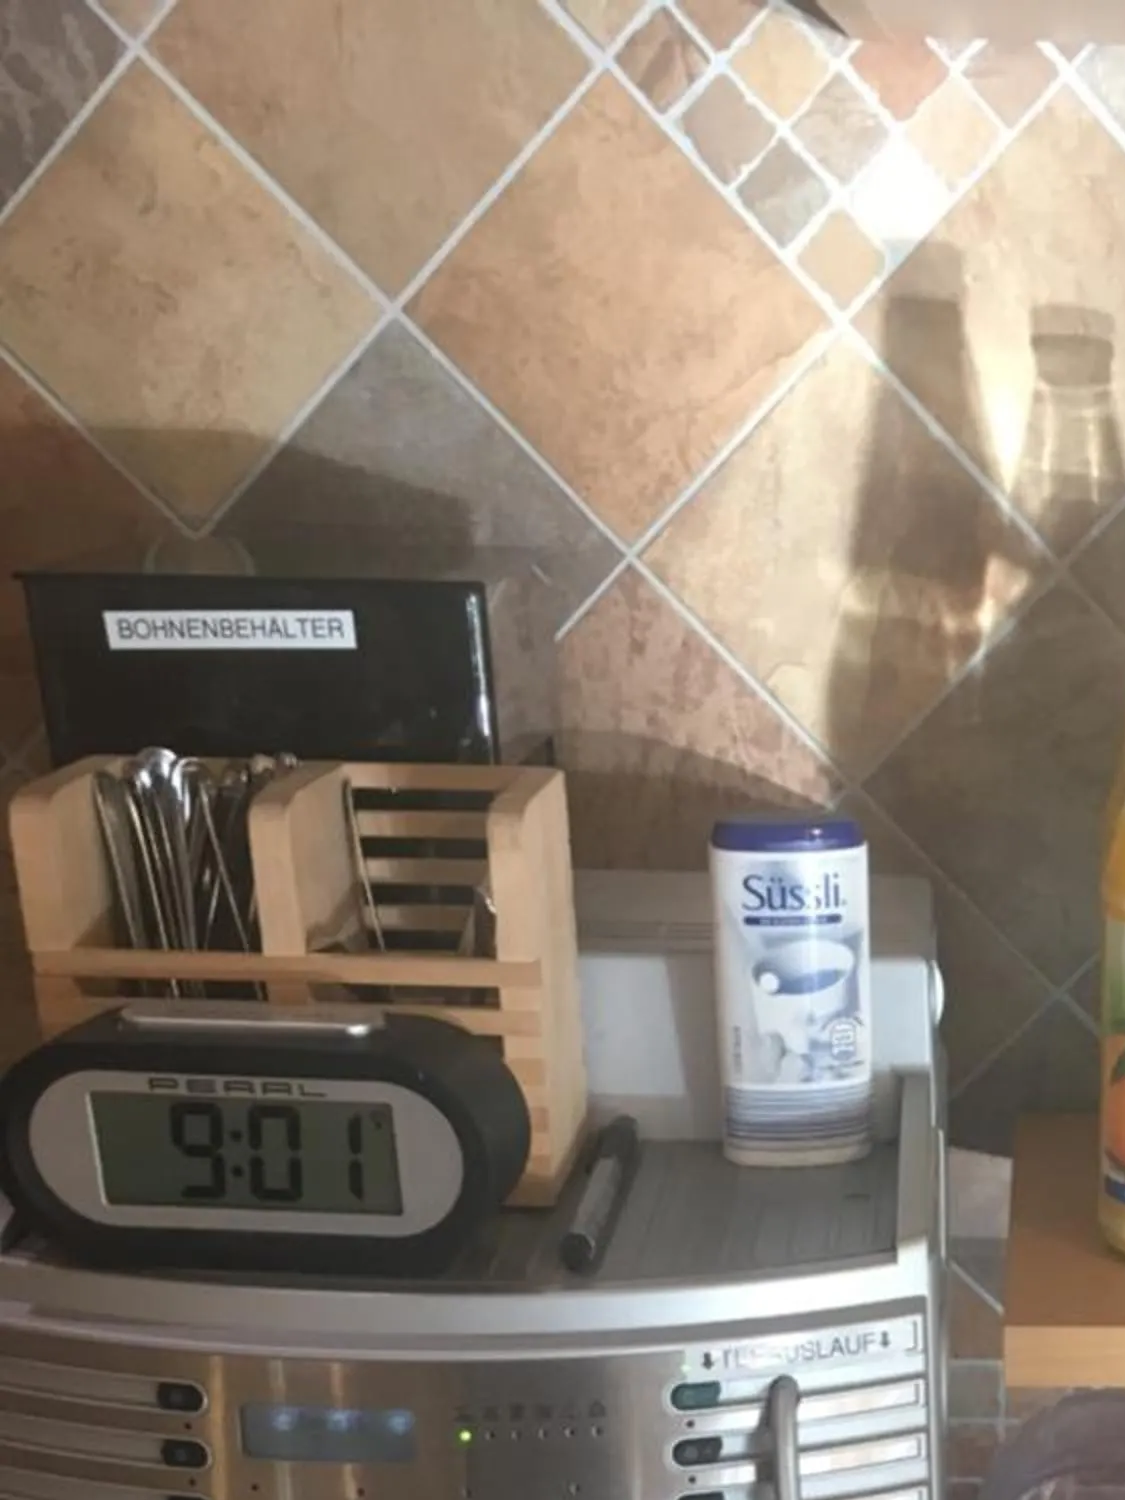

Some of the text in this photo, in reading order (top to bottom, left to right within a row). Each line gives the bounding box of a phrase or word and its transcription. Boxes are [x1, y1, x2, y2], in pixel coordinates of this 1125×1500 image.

[148, 1077, 327, 1099] PEARL
[170, 1102, 364, 1201] 9:01
[722, 1331, 876, 1370] TEUSLAUF
